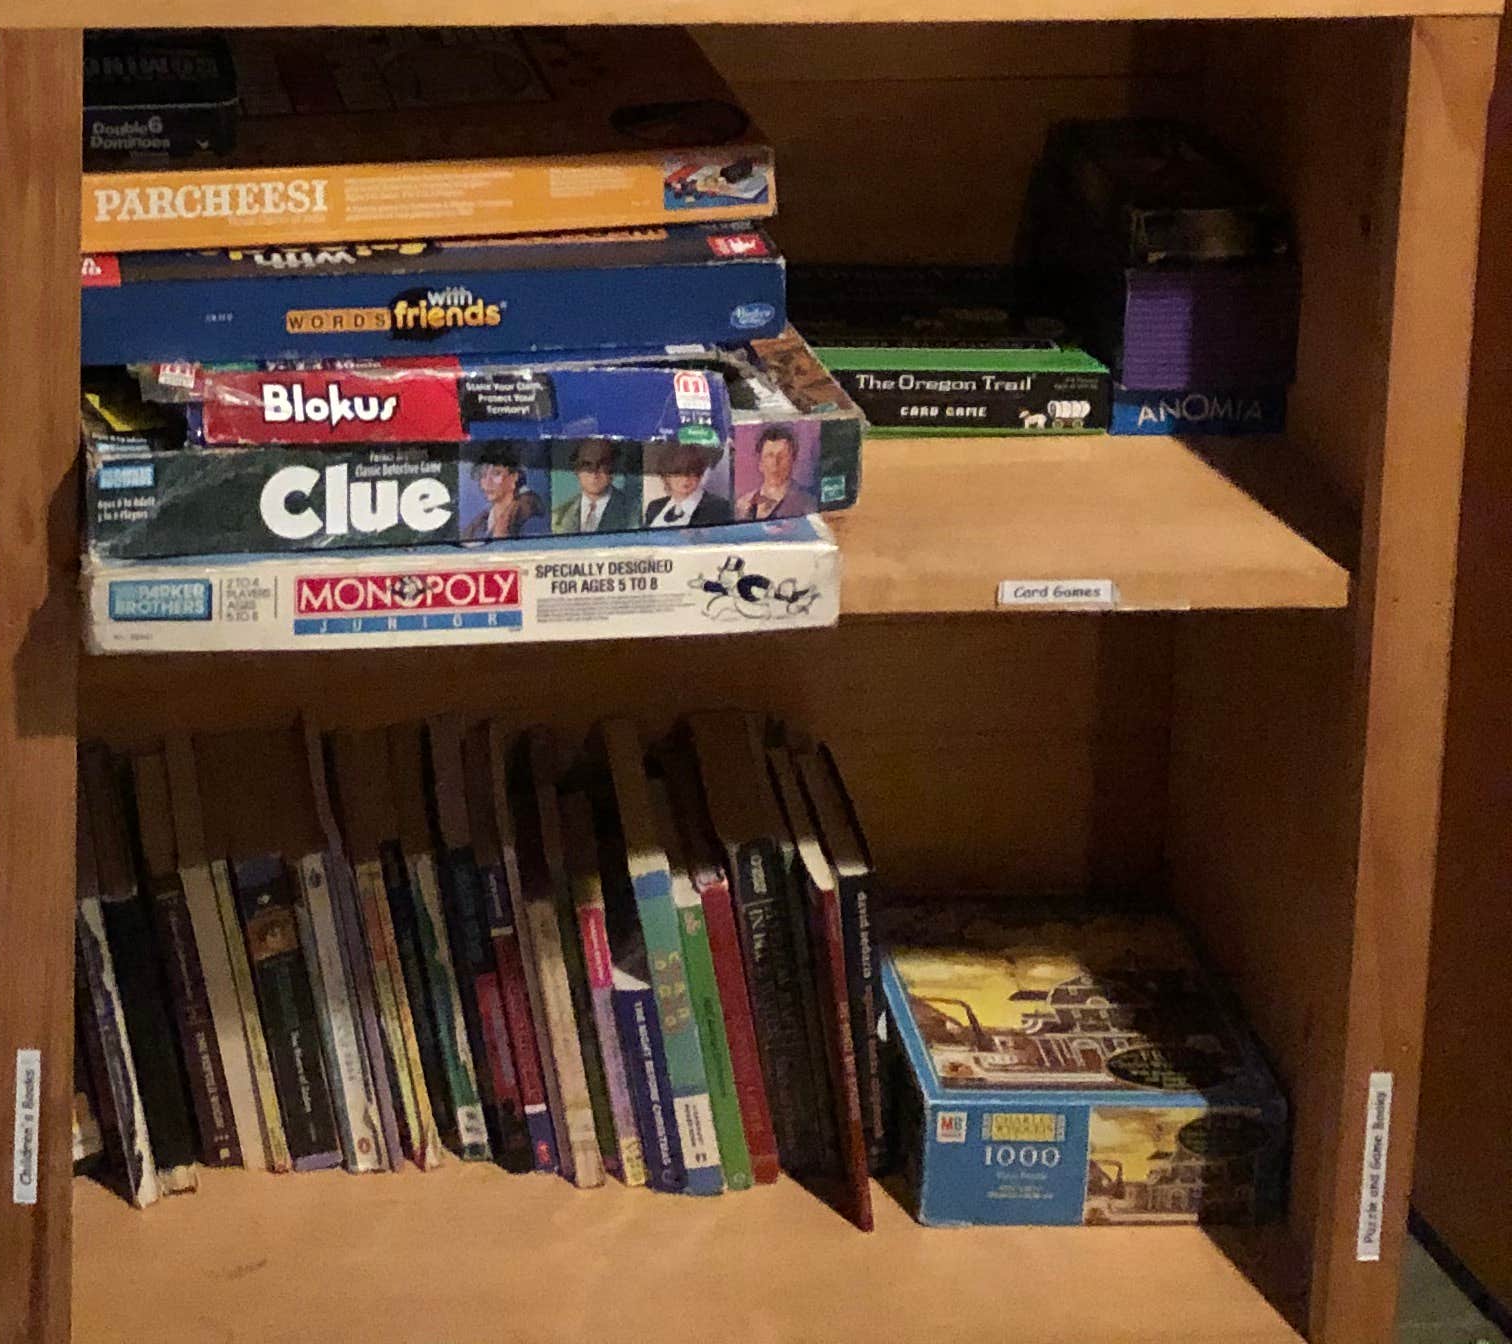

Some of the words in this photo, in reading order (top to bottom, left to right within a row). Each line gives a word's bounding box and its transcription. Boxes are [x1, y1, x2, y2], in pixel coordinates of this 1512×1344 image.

[93, 178, 330, 223] PARCHEESI
[428, 288, 474, 308] with
[394, 299, 503, 330] friends
[856, 374, 895, 393] The
[898, 374, 979, 394] Oregon
[982, 374, 1033, 392] Trail
[262, 382, 398, 424] Blokus
[899, 404, 940, 419] CARD
[945, 404, 988, 419] GAME
[1138, 392, 1264, 426] ANOMIA
[259, 463, 452, 541] Clue
[534, 562, 605, 579] SPECIALLY
[607, 558, 674, 576] DESIGNED
[296, 570, 519, 614] MONOPOLY
[550, 579, 577, 595] FOR
[579, 579, 616, 594] AGES
[630, 578, 649, 592] TO
[1012, 585, 1050, 600] Card
[1055, 585, 1103, 600] Games
[18, 1112, 35, 1186] Children's
[983, 1143, 1062, 1167] 1000
[1368, 1134, 1384, 1171] Game
[1367, 1174, 1381, 1198] and
[1362, 1202, 1378, 1245] Puzzle
